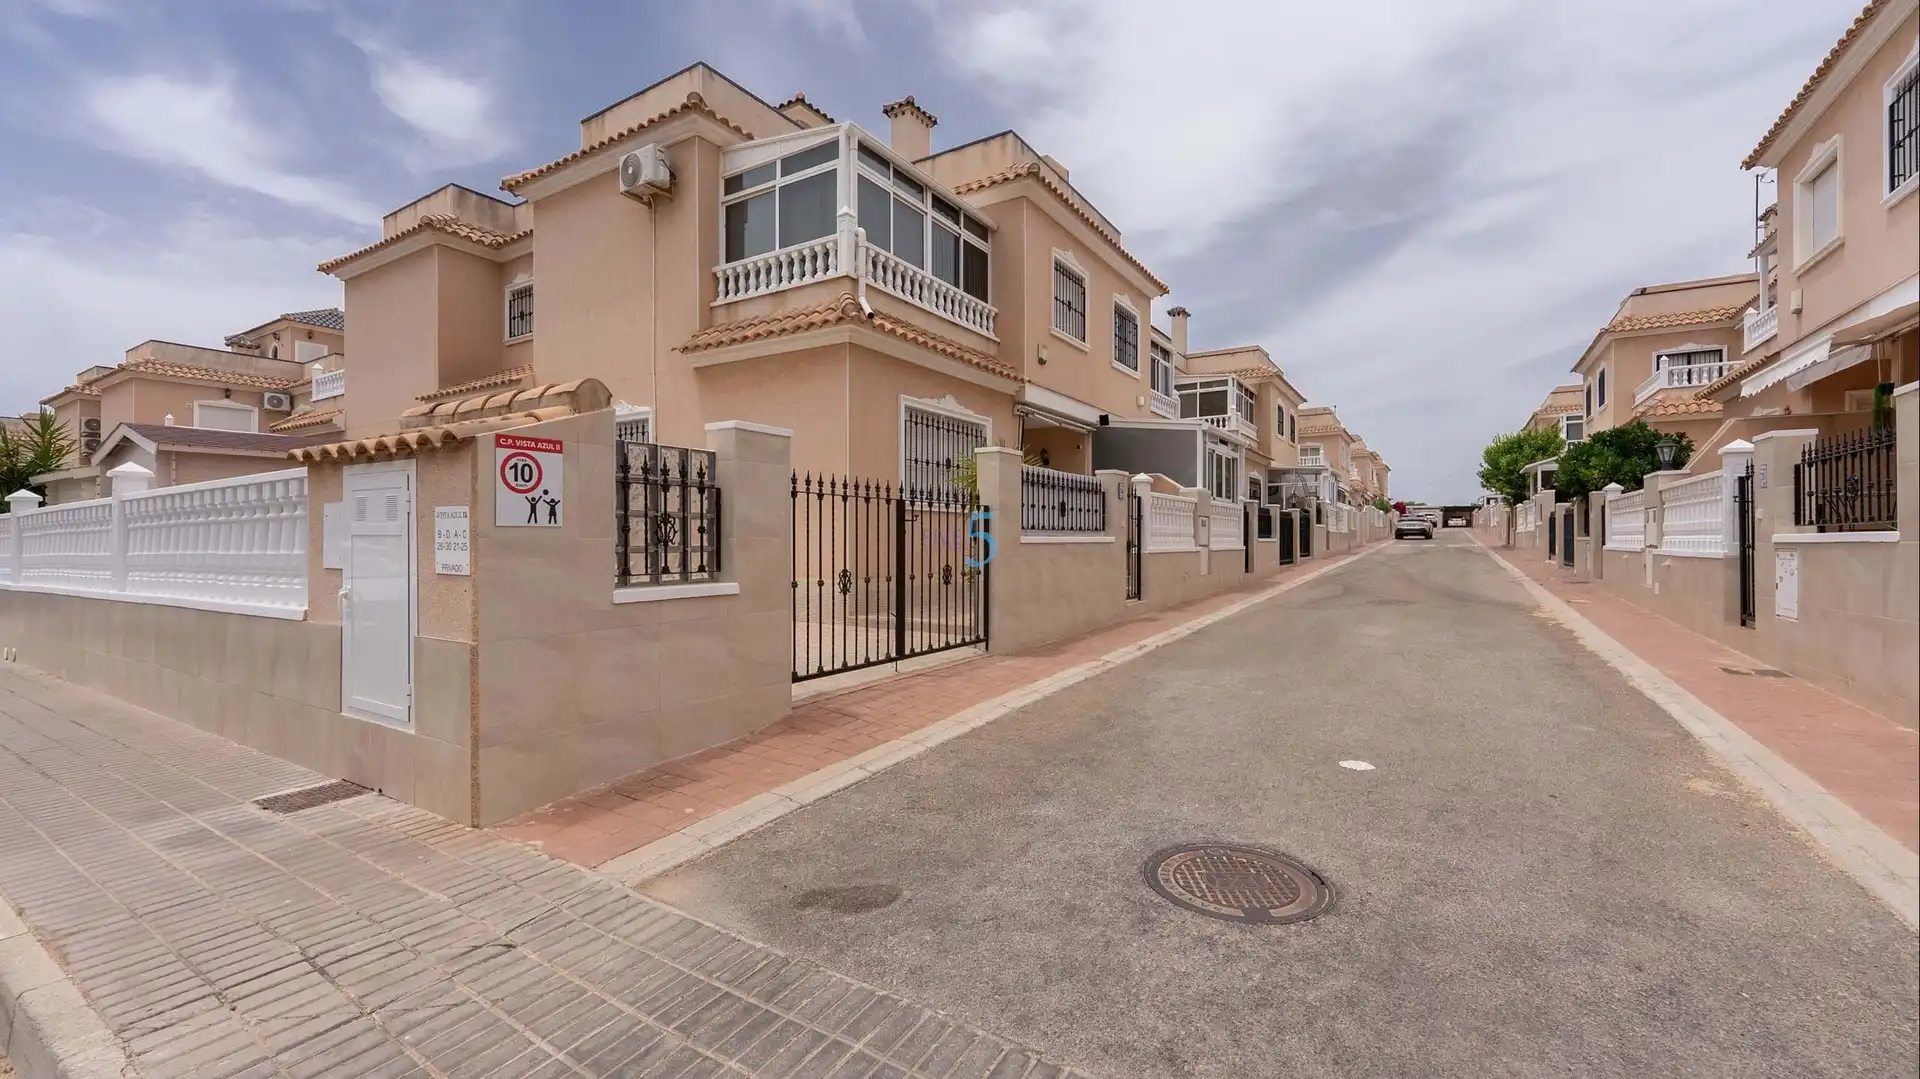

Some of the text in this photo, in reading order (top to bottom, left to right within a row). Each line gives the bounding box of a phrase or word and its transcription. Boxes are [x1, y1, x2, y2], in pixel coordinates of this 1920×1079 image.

[515, 440, 536, 448] VISTA
[537, 442, 555, 450] AZUL
[509, 462, 533, 483] 10
[441, 563, 463, 572] PRIVADO
